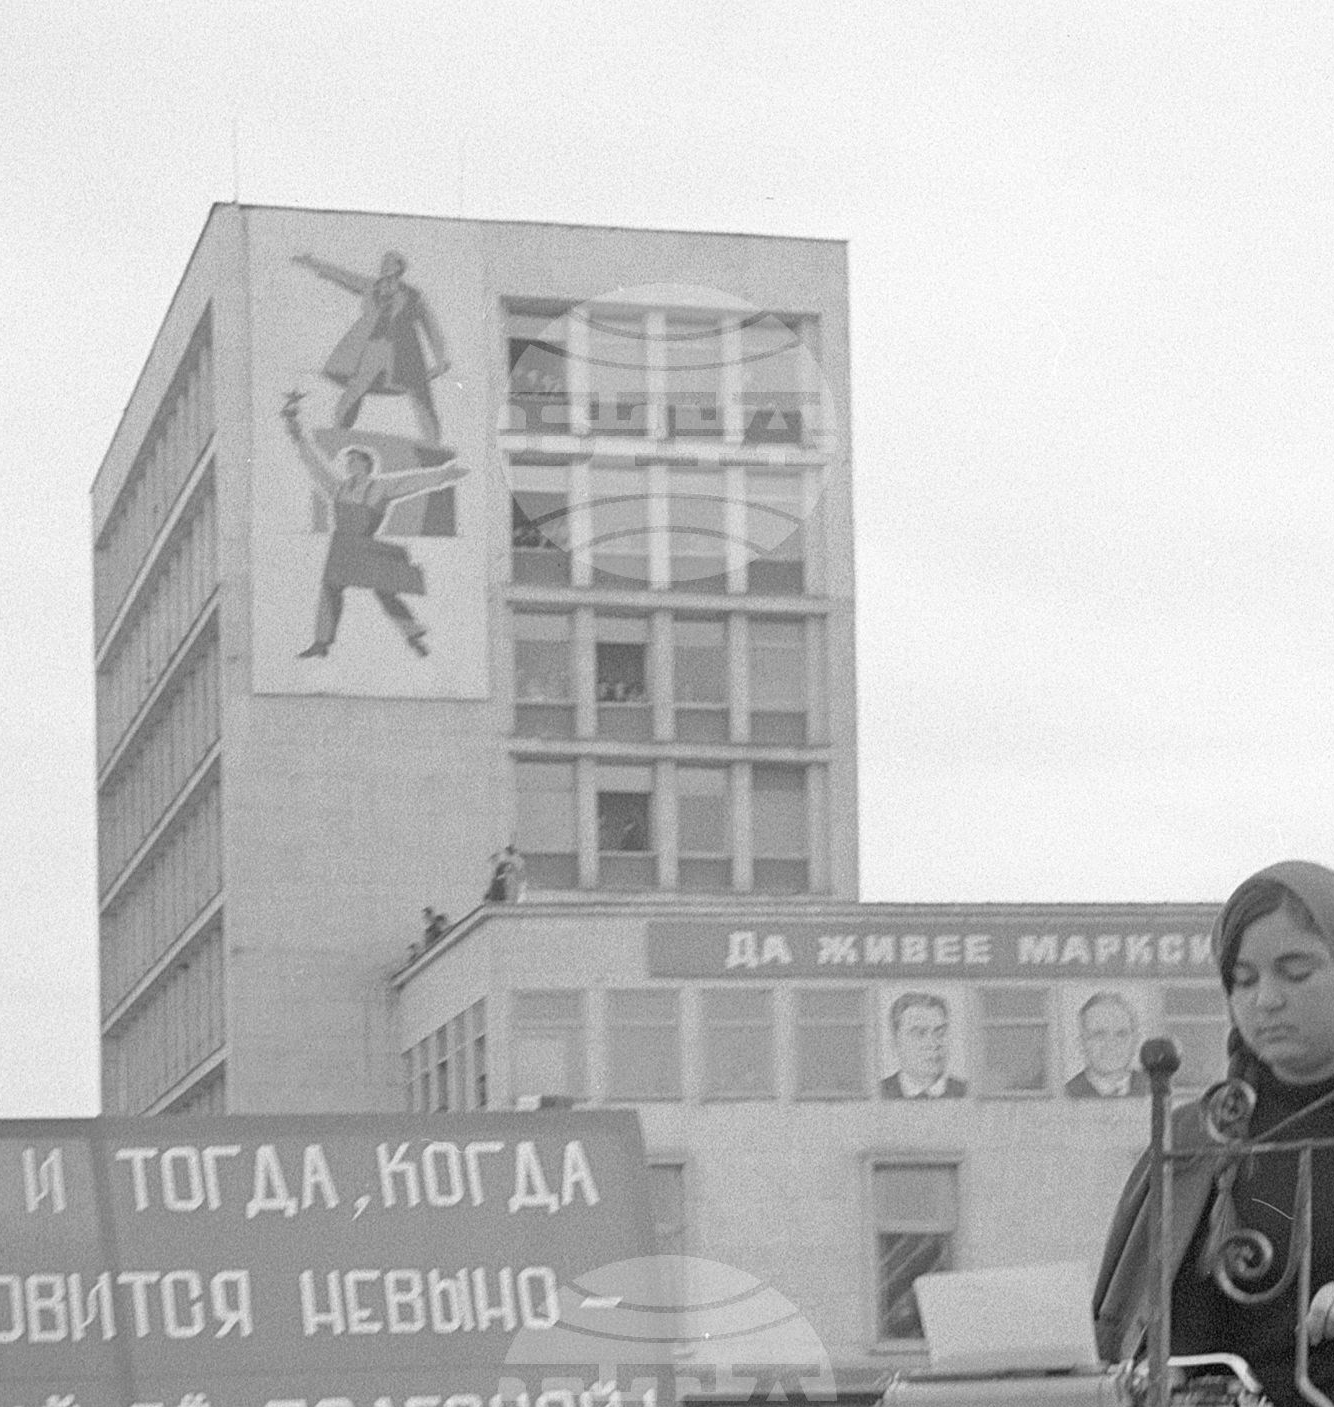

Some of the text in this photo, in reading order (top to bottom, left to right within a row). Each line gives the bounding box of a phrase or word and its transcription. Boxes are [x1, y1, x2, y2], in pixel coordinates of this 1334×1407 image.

[725, 931, 793, 968] ДА
[817, 934, 993, 965] ЖИВЕЕ
[1017, 934, 1212, 965] МАРКСИ
[22, 1147, 66, 1214] И
